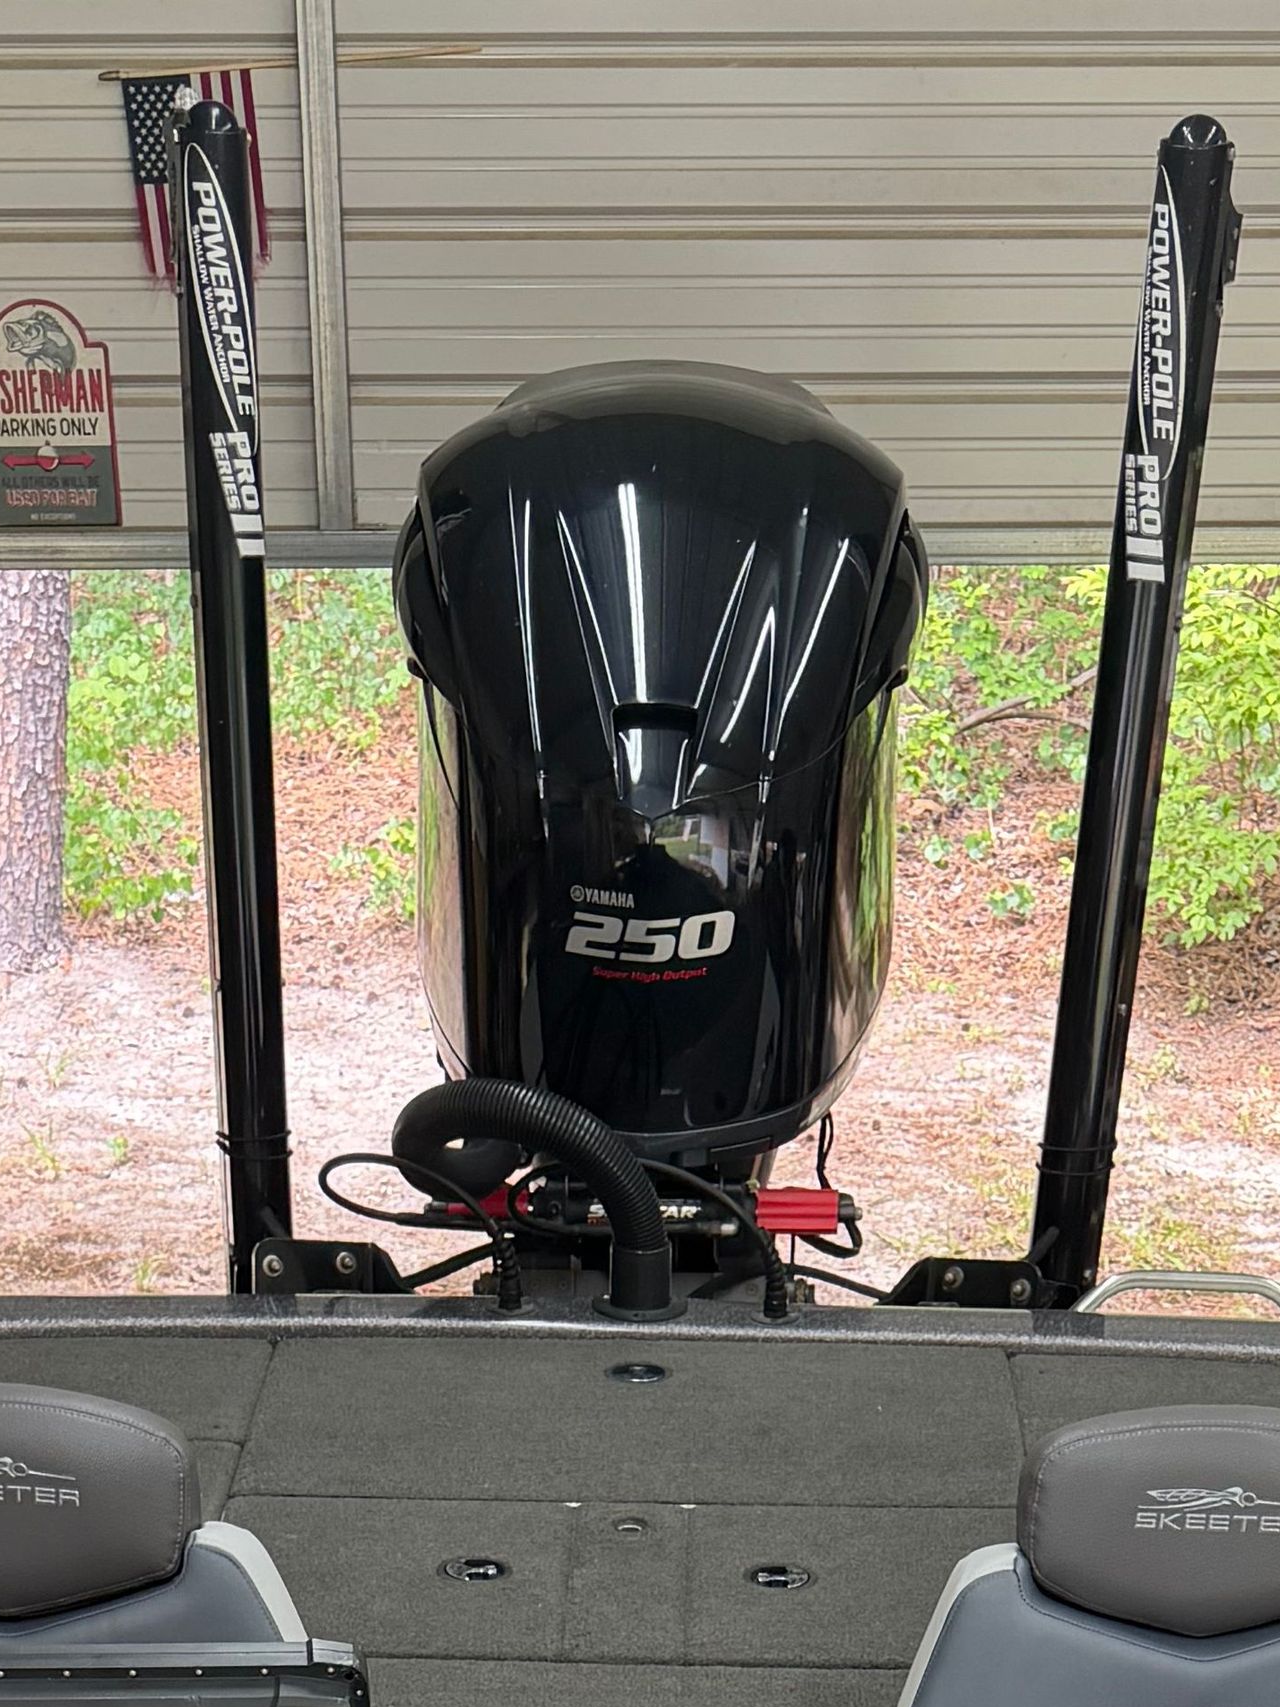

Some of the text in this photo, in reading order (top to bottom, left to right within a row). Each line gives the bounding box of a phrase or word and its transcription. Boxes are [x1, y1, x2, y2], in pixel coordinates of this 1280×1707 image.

[192, 181, 256, 418] POWER-POLE
[203, 287, 220, 331] WATER
[1143, 308, 1152, 353] WATER
[1150, 203, 1174, 442] POWER-POLE
[60, 417, 99, 436] ONLY
[209, 432, 242, 512] SERIES
[226, 431, 260, 512] PRO
[1124, 453, 1139, 534] SERIES
[1137, 455, 1162, 535] PRO
[584, 887, 635, 909] YAMAHA
[565, 910, 736, 963] 250
[592, 965, 708, 983] Super High Output
